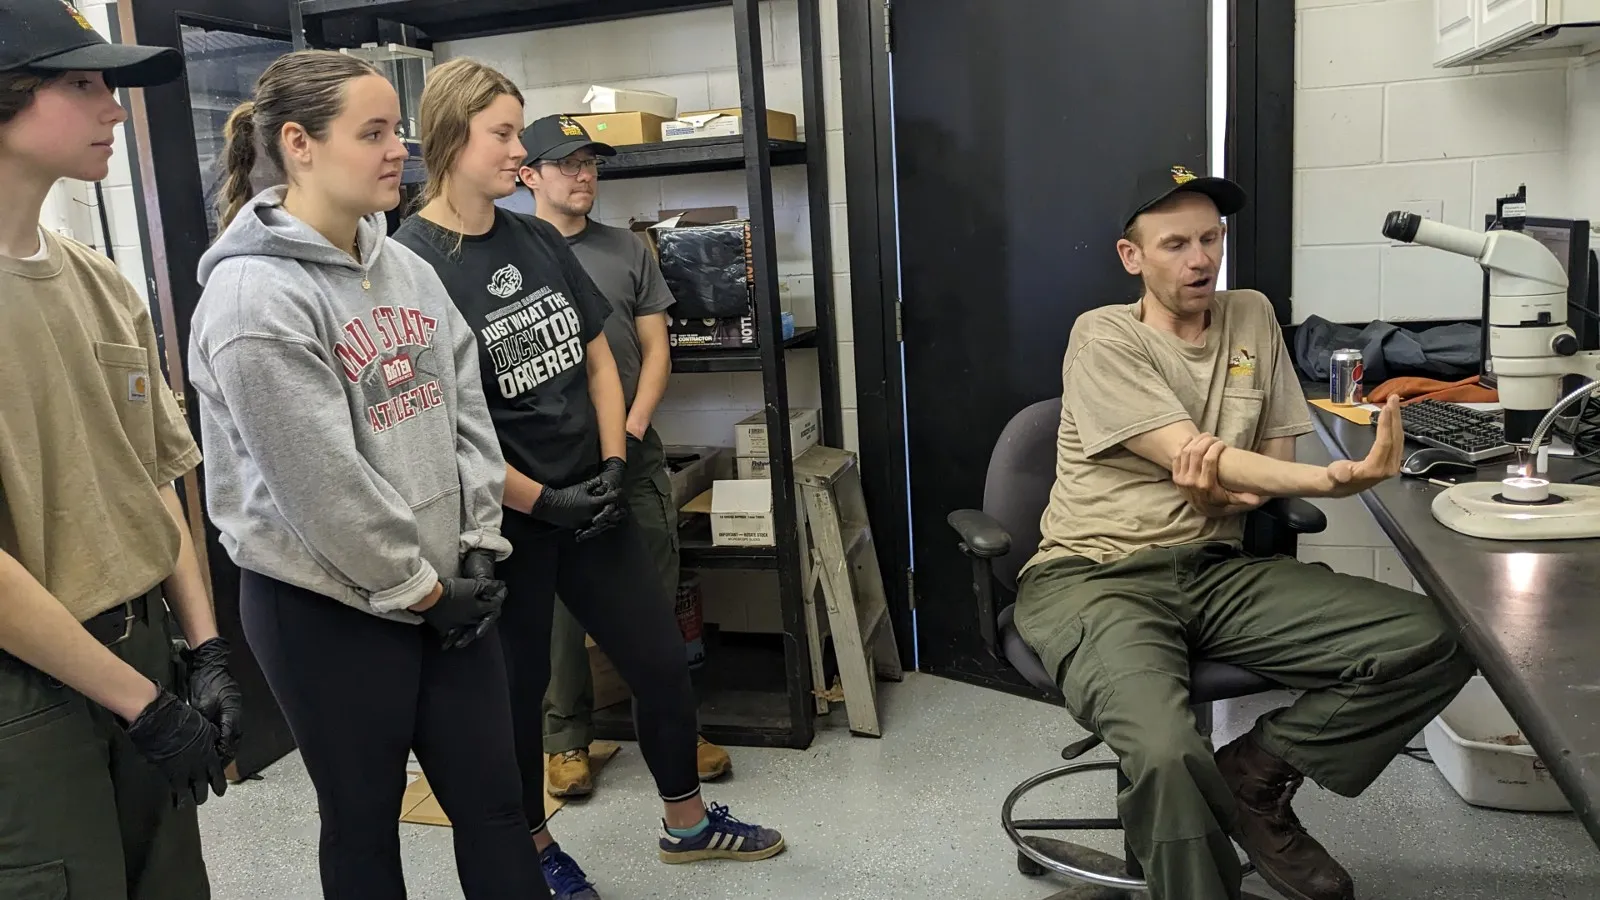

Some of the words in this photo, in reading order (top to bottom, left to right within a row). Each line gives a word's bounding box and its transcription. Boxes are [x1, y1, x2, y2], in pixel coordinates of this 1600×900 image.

[372, 305, 438, 350] STATE
[481, 318, 513, 346] JUST
[508, 301, 546, 331] WHAT
[543, 292, 569, 312] THE
[678, 335, 713, 343] CONTRACTOR
[368, 379, 445, 434] ATLETIC
